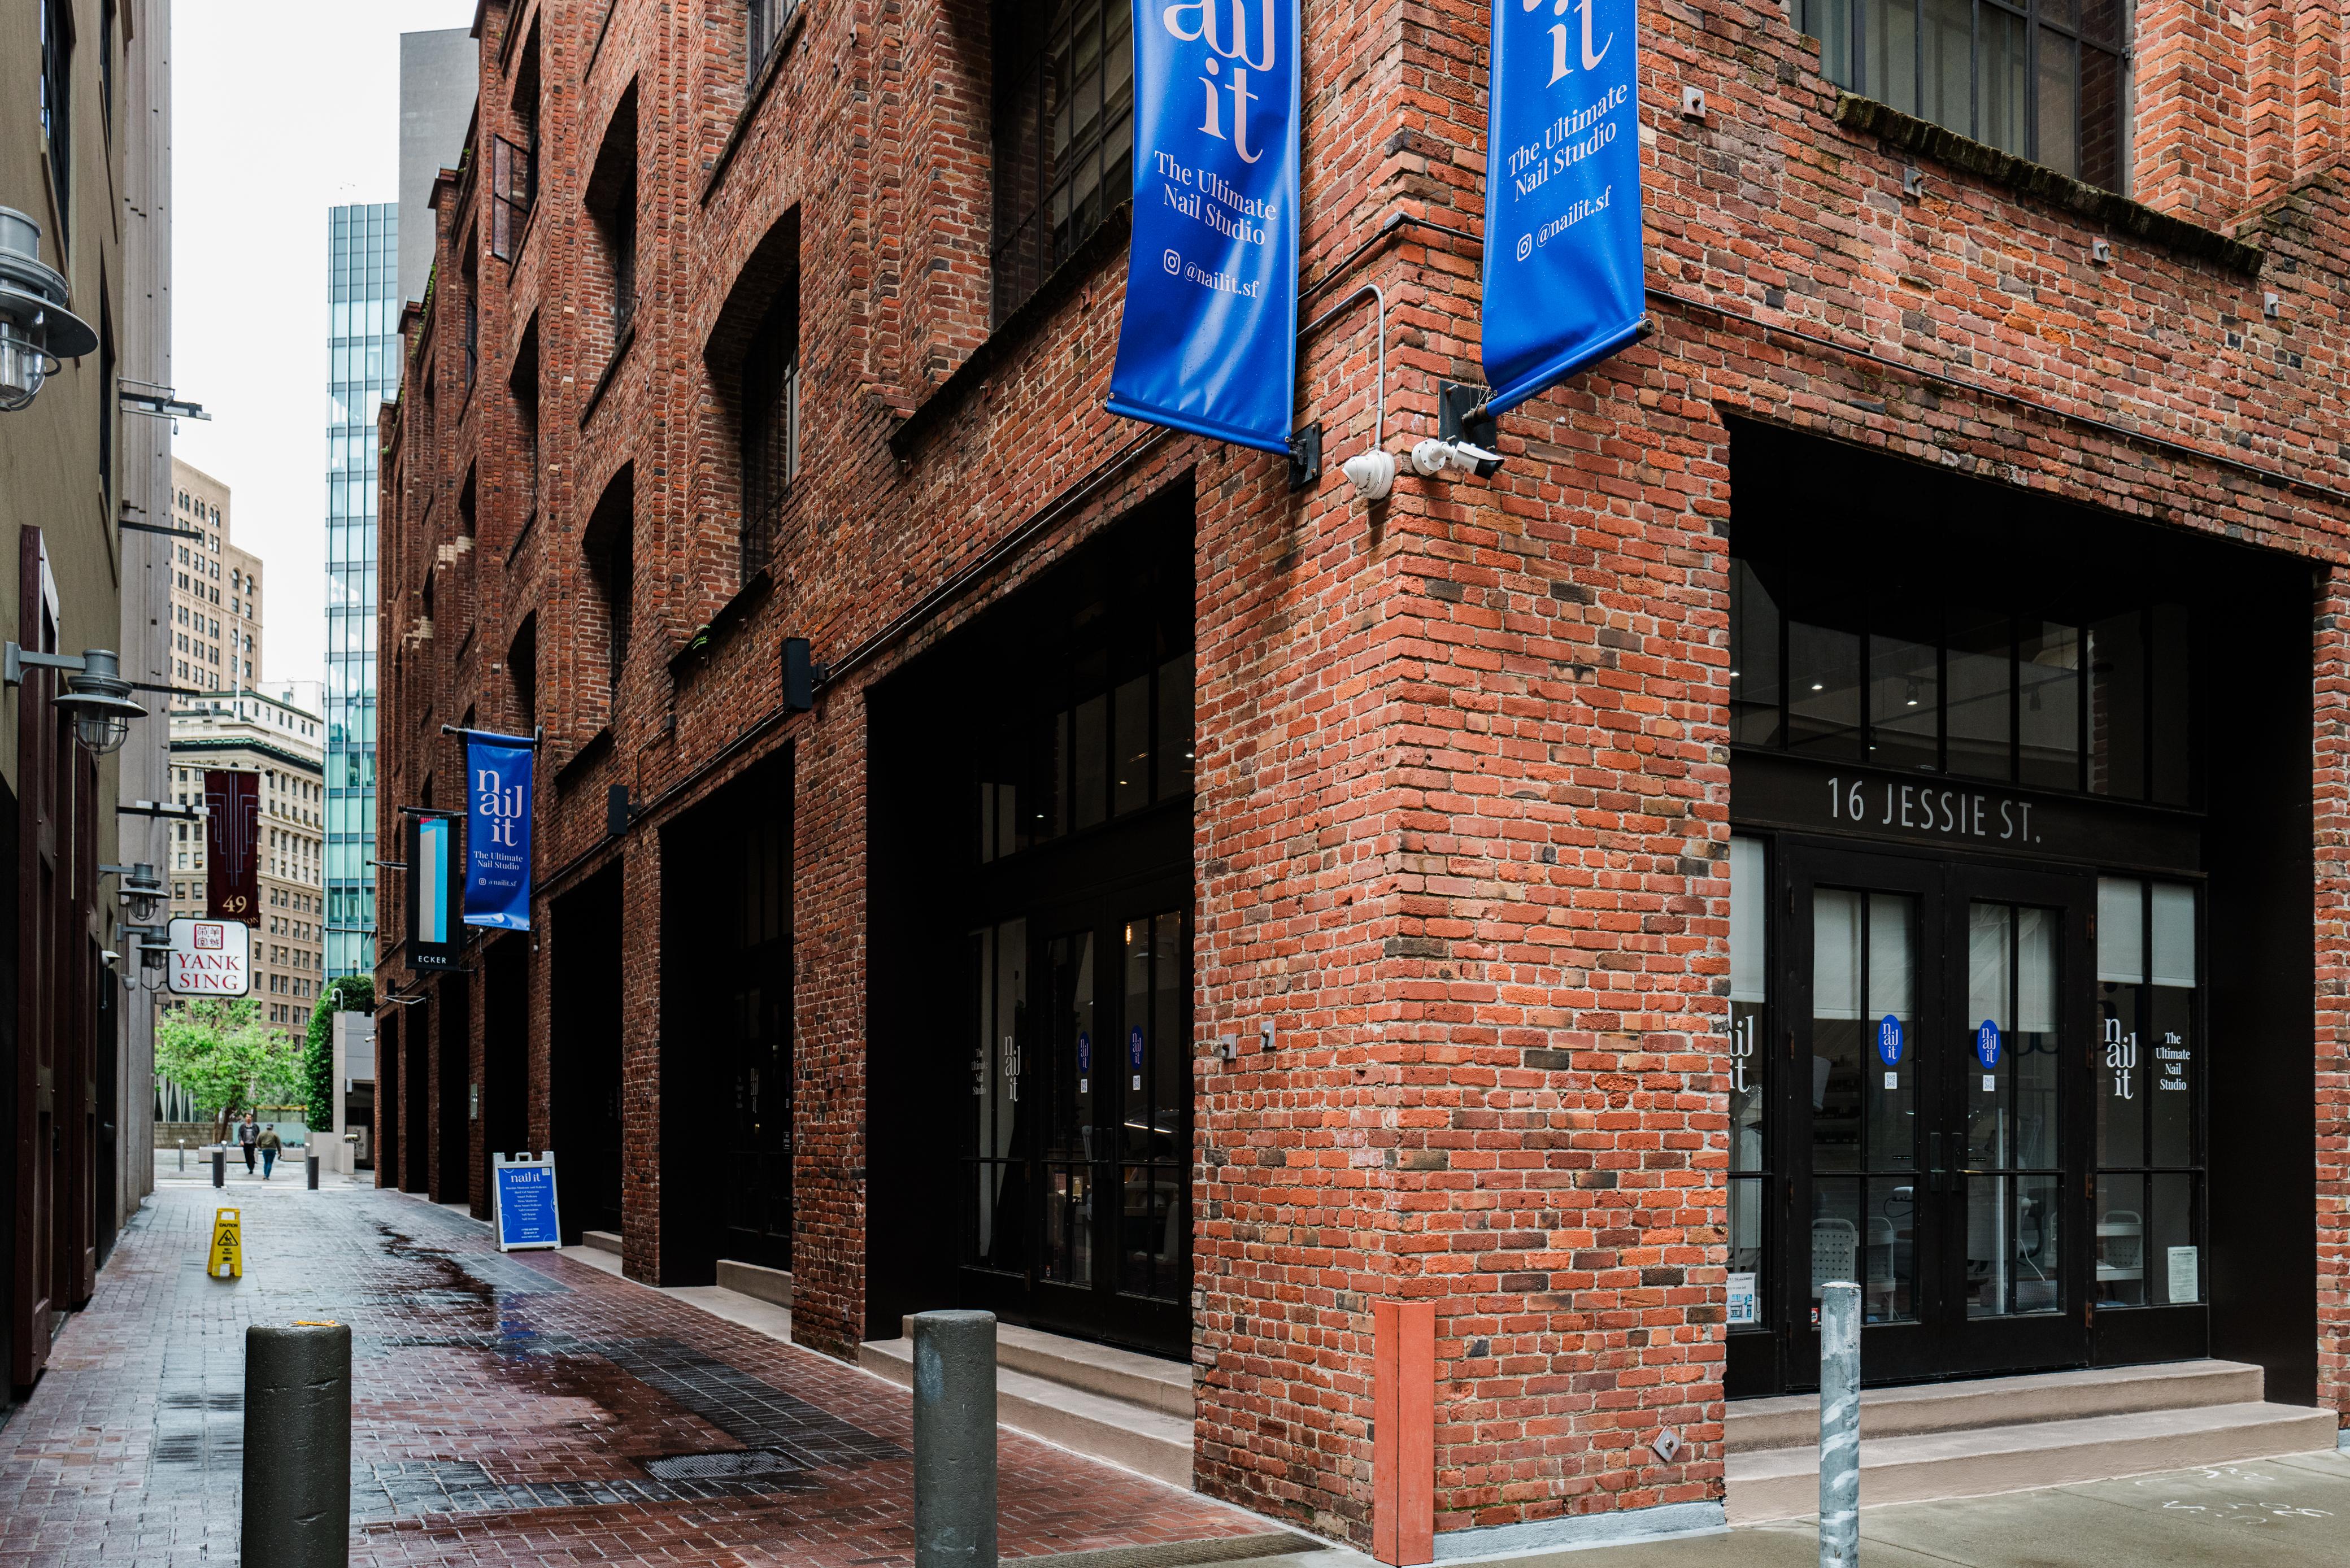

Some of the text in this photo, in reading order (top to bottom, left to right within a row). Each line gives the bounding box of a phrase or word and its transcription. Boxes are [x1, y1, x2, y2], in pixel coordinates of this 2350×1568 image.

[1198, 57, 1263, 164] it
[1508, 84, 1628, 177] The Ultimate
[1515, 122, 1616, 202] Nail Studio
[1154, 150, 1276, 221] The Ultimate
[1163, 183, 1265, 245] Nail Studio
[1537, 185, 1612, 247] @nailit.sf
[1184, 262, 1260, 298] @nailit.sf
[1828, 777, 2041, 843] 16 JESSIE ST.
[491, 817, 519, 847] it
[473, 851, 523, 863] The Ultimate
[477, 860, 519, 870] Nail Studio
[223, 895, 247, 913] 49
[177, 953, 241, 971] YANK
[418, 955, 446, 964] ECKER
[180, 973, 238, 990] SING
[2165, 1032, 2181, 1044] The
[1888, 1046, 1898, 1060] it
[1986, 1049, 1995, 1063] it
[2156, 1047, 2191, 1060] Ultimate
[971, 1060, 988, 1071] Ultimate
[2165, 1063, 2181, 1075] Nail
[973, 1084, 986, 1096] Studio
[1008, 1077, 1019, 1102] it
[2114, 1069, 2134, 1100] it
[2160, 1078, 2187, 1091] Studio
[511, 1171, 541, 1183] nail it
